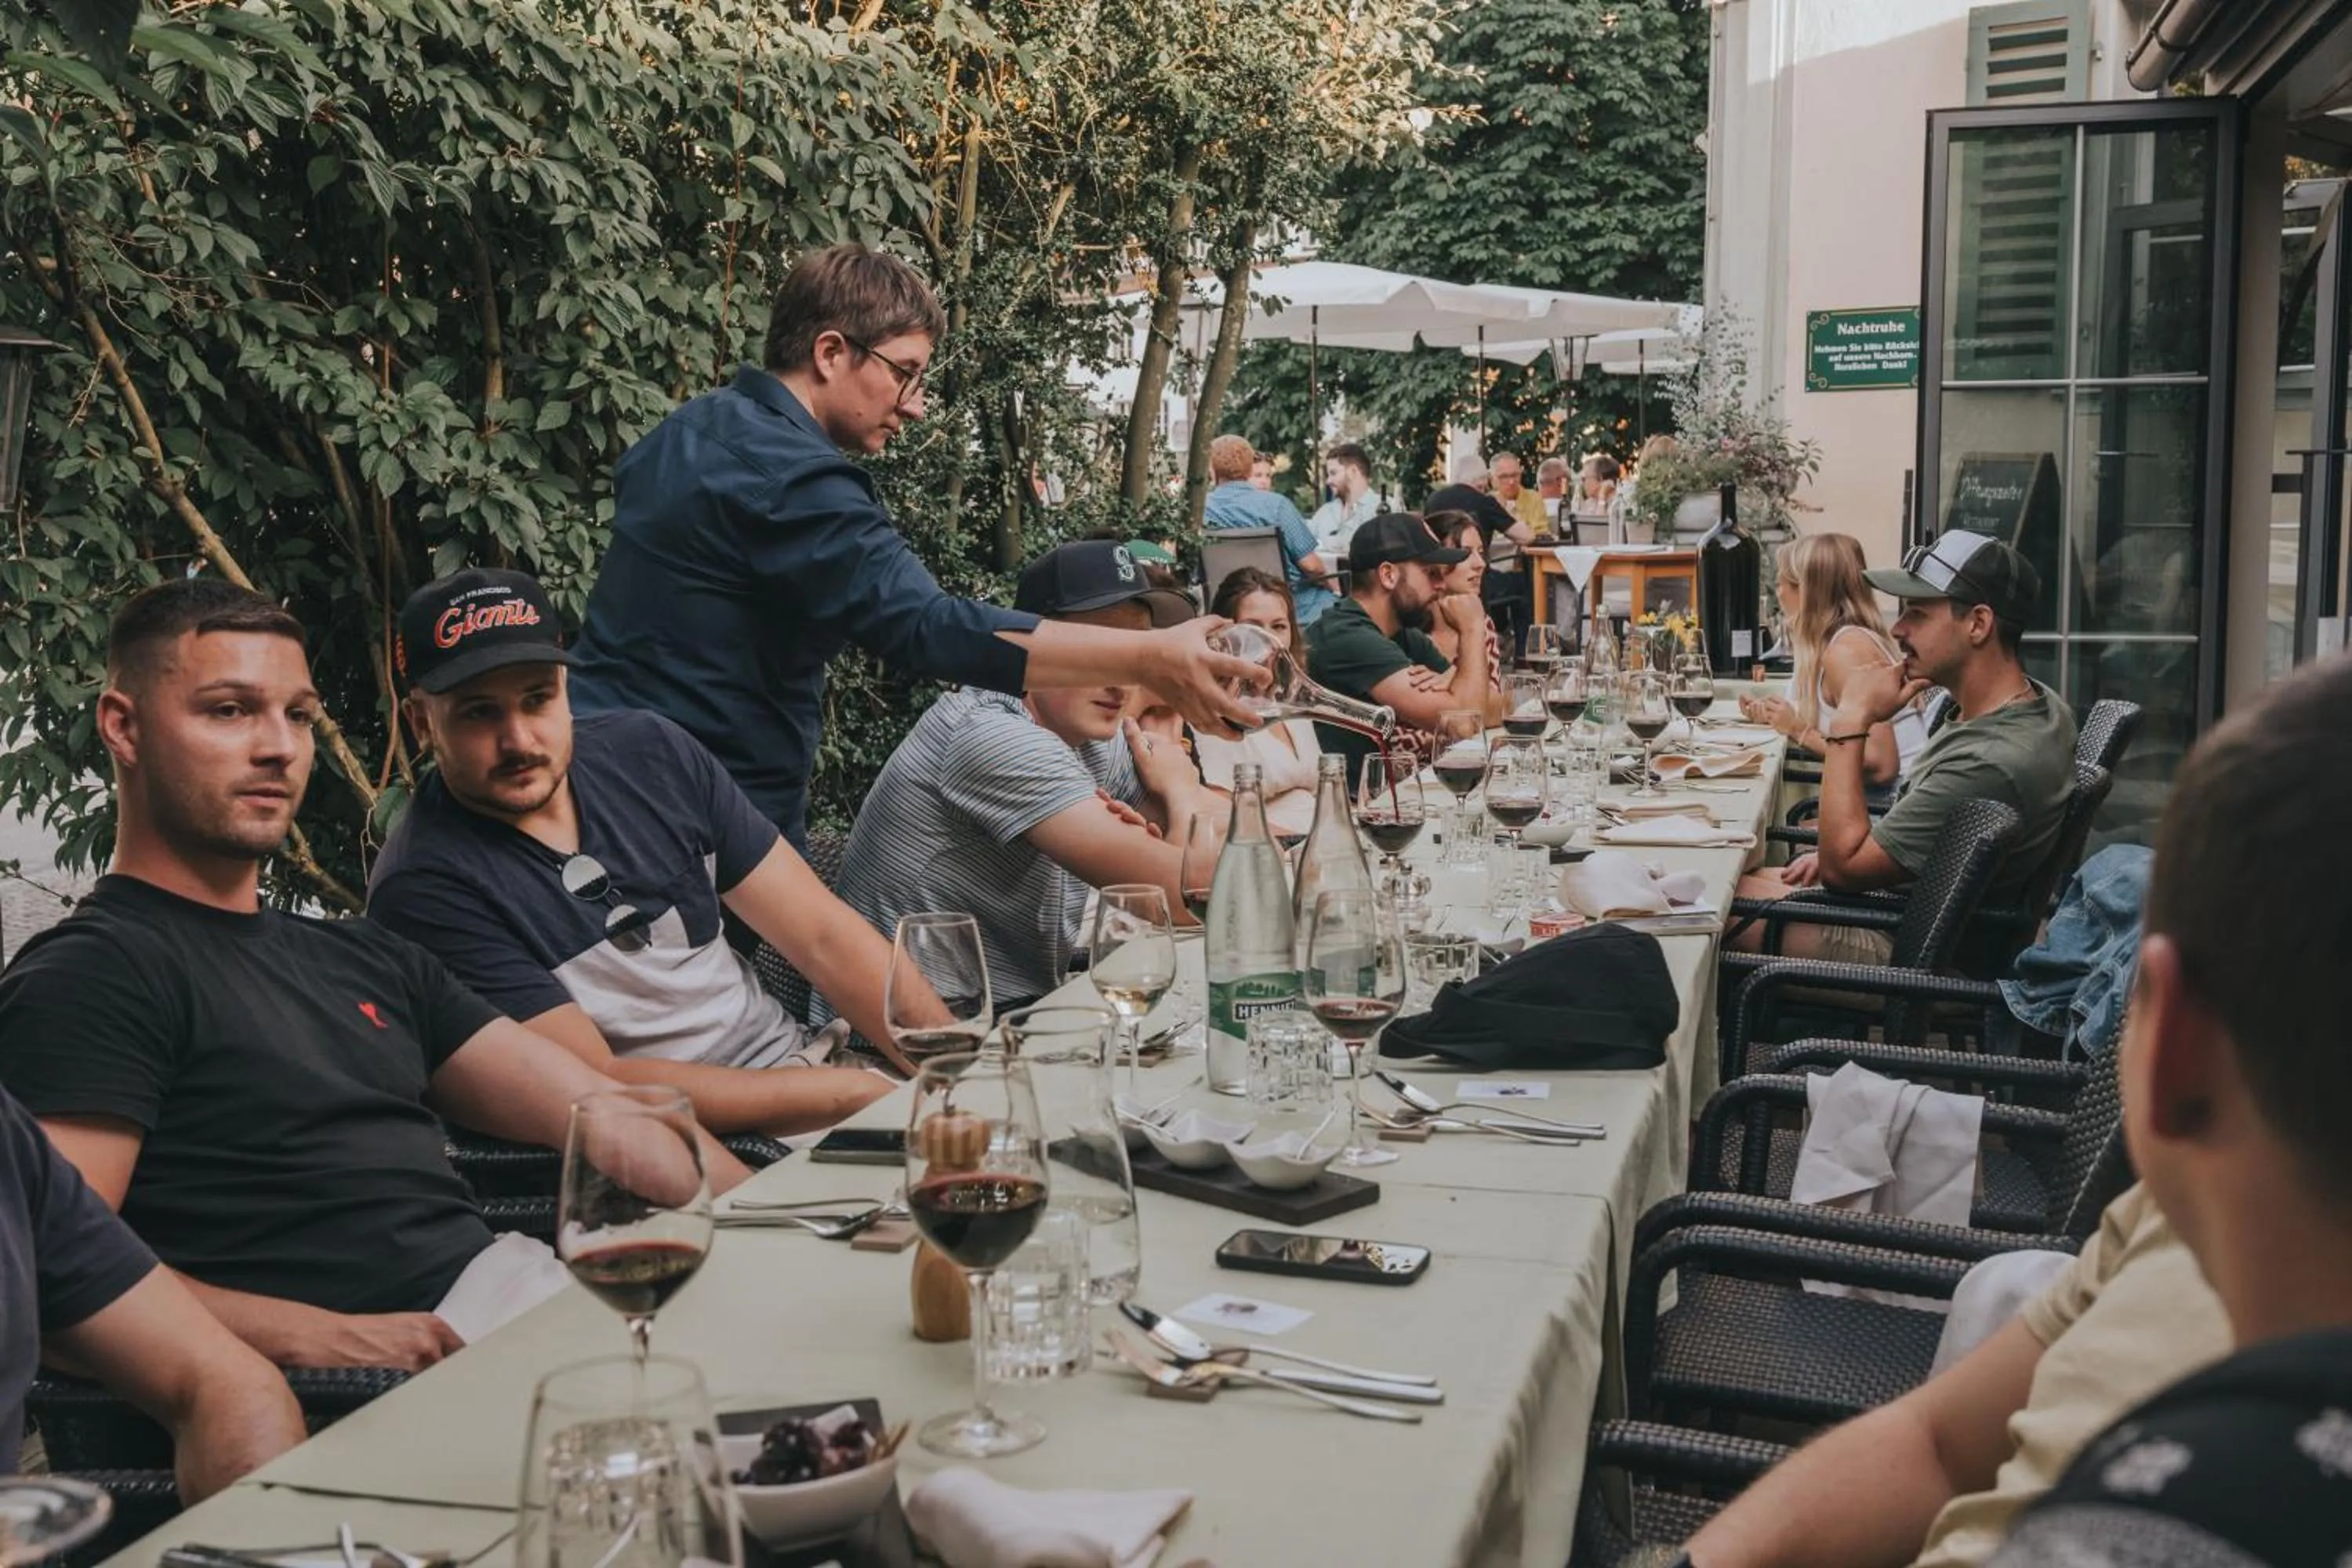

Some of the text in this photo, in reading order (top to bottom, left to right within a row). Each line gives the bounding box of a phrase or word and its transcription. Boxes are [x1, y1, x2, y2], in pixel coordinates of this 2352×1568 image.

[1837, 321, 1906, 336] Nachtruhe
[1849, 343, 1862, 352] Sie
[1828, 354, 1843, 362] auf
[449, 586, 512, 606] SAN FRANCISCO
[434, 597, 541, 648] Giants
